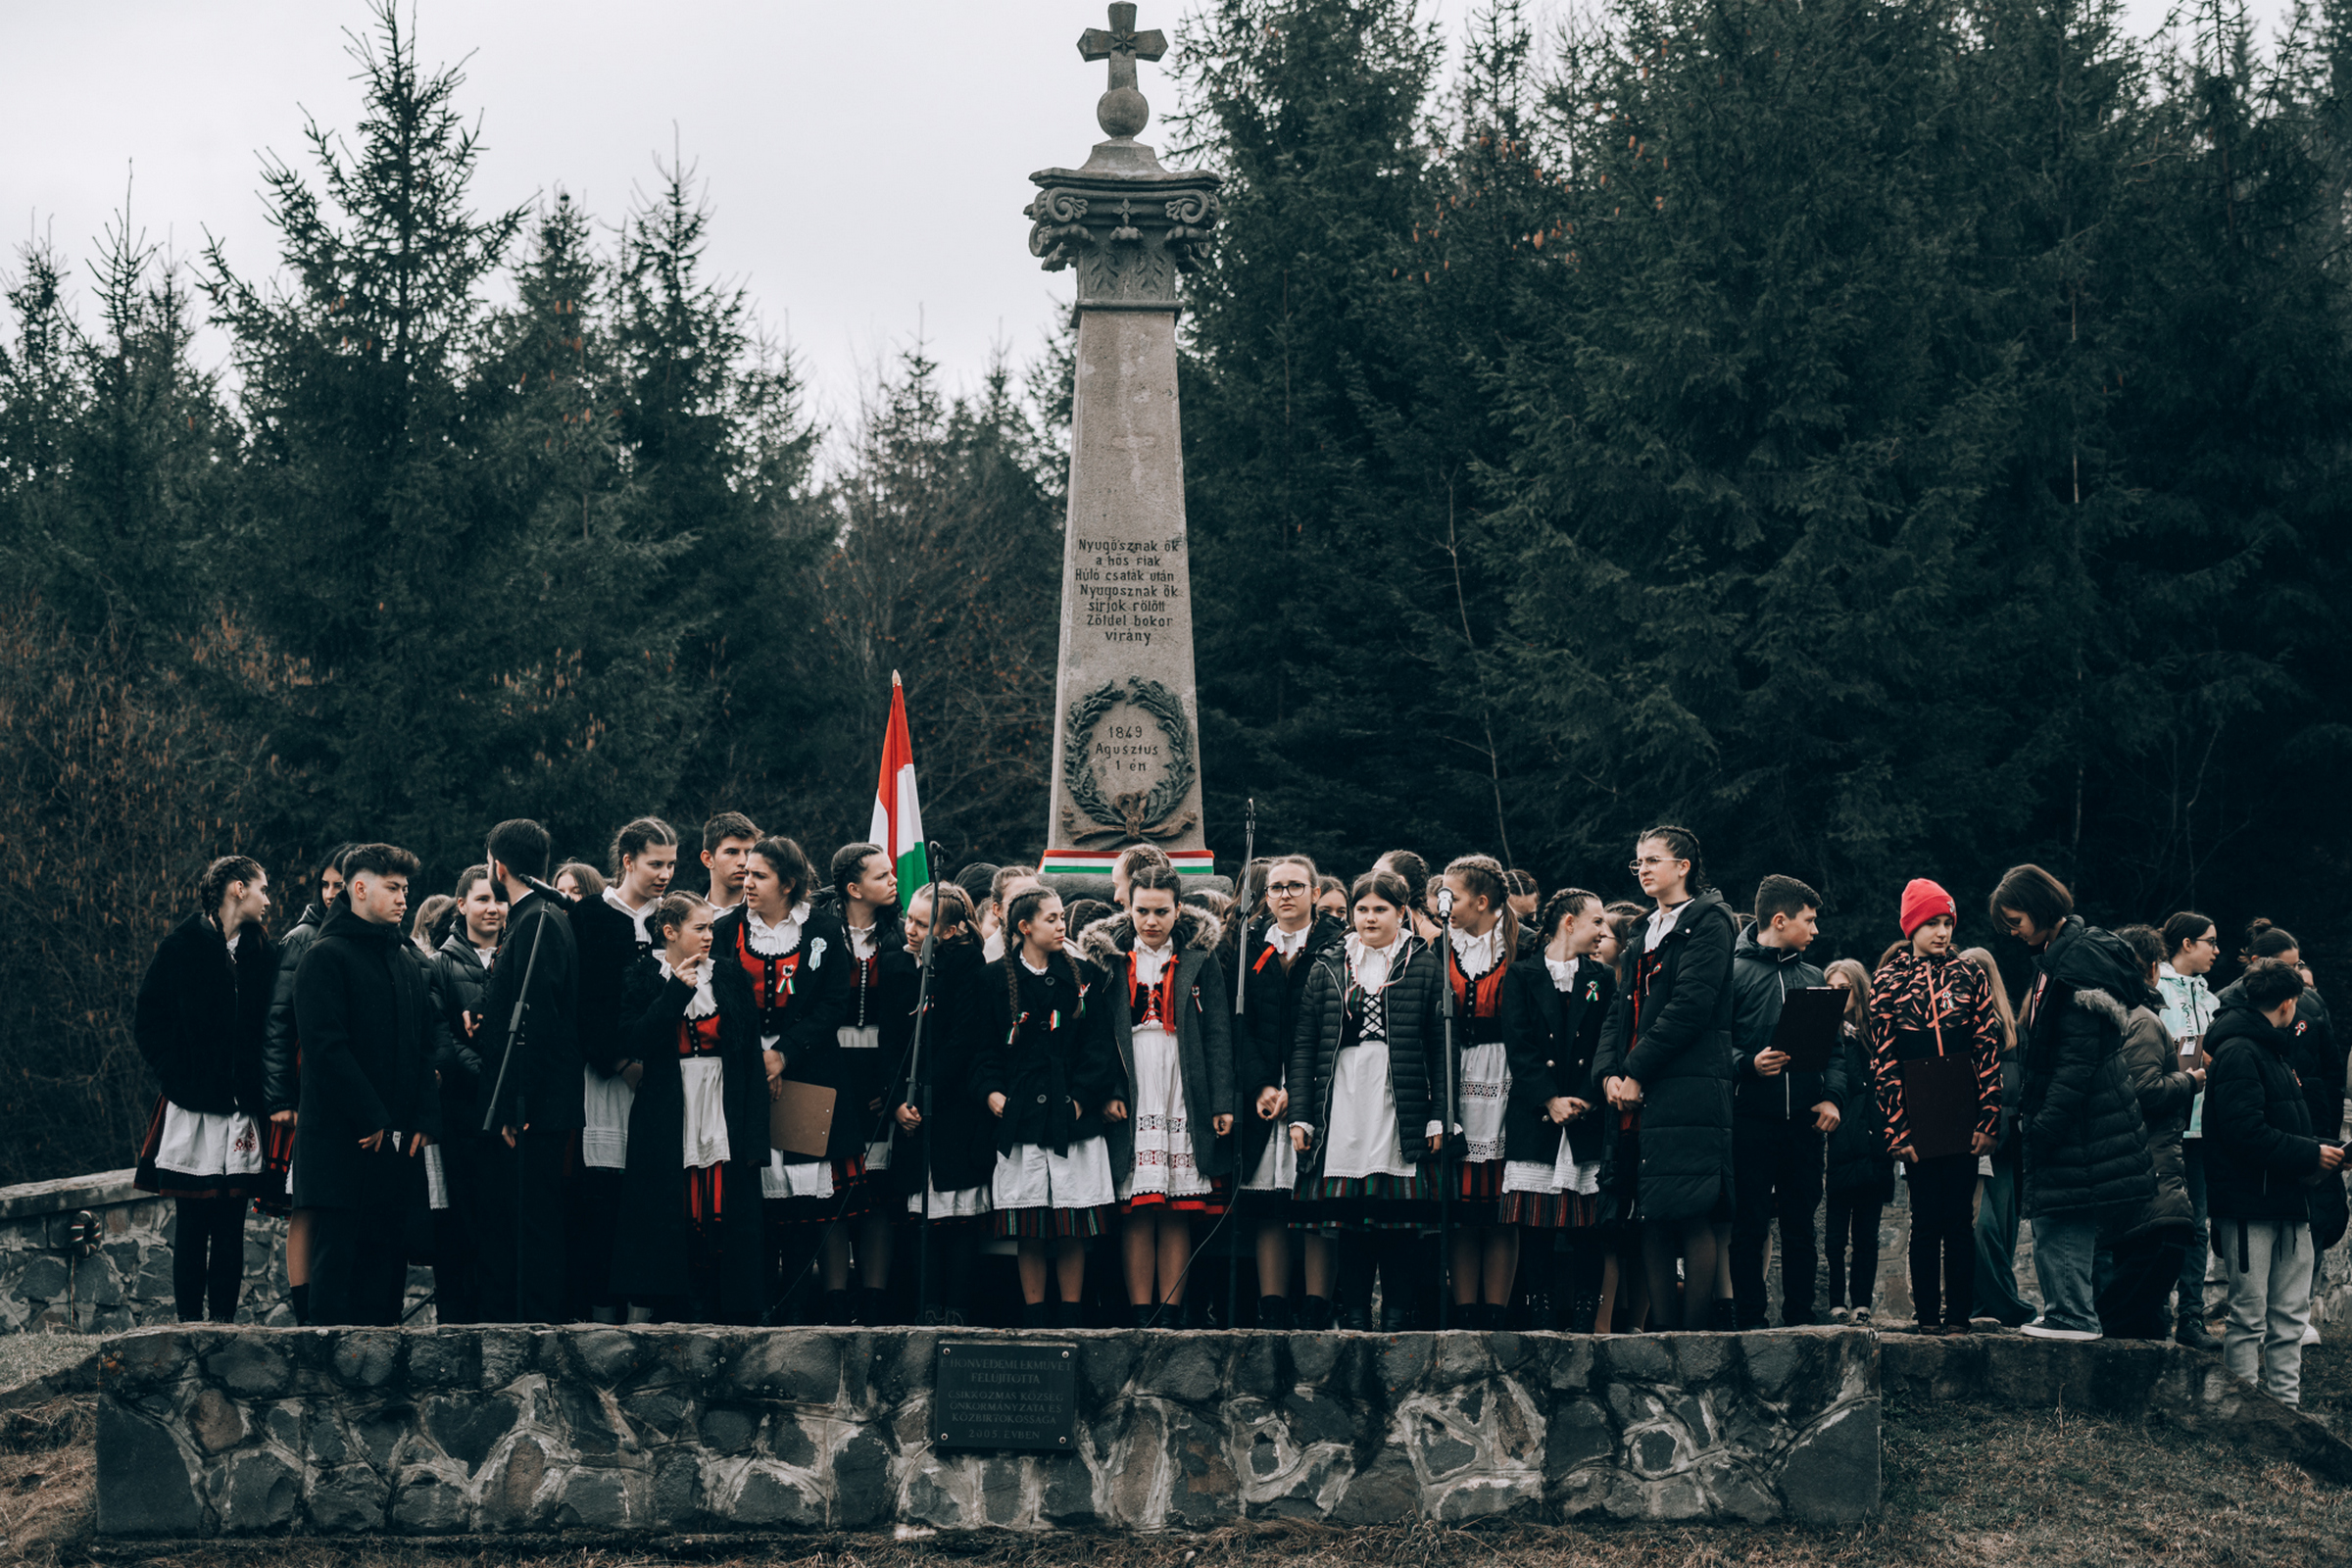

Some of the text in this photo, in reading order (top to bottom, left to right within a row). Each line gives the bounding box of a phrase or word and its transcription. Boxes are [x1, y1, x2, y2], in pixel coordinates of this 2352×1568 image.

[1096, 557, 1102, 565] a
[1087, 614, 1173, 627] Zöldel bokor
[1108, 726, 1143, 739] 1849
[1115, 760, 1120, 770] 1
